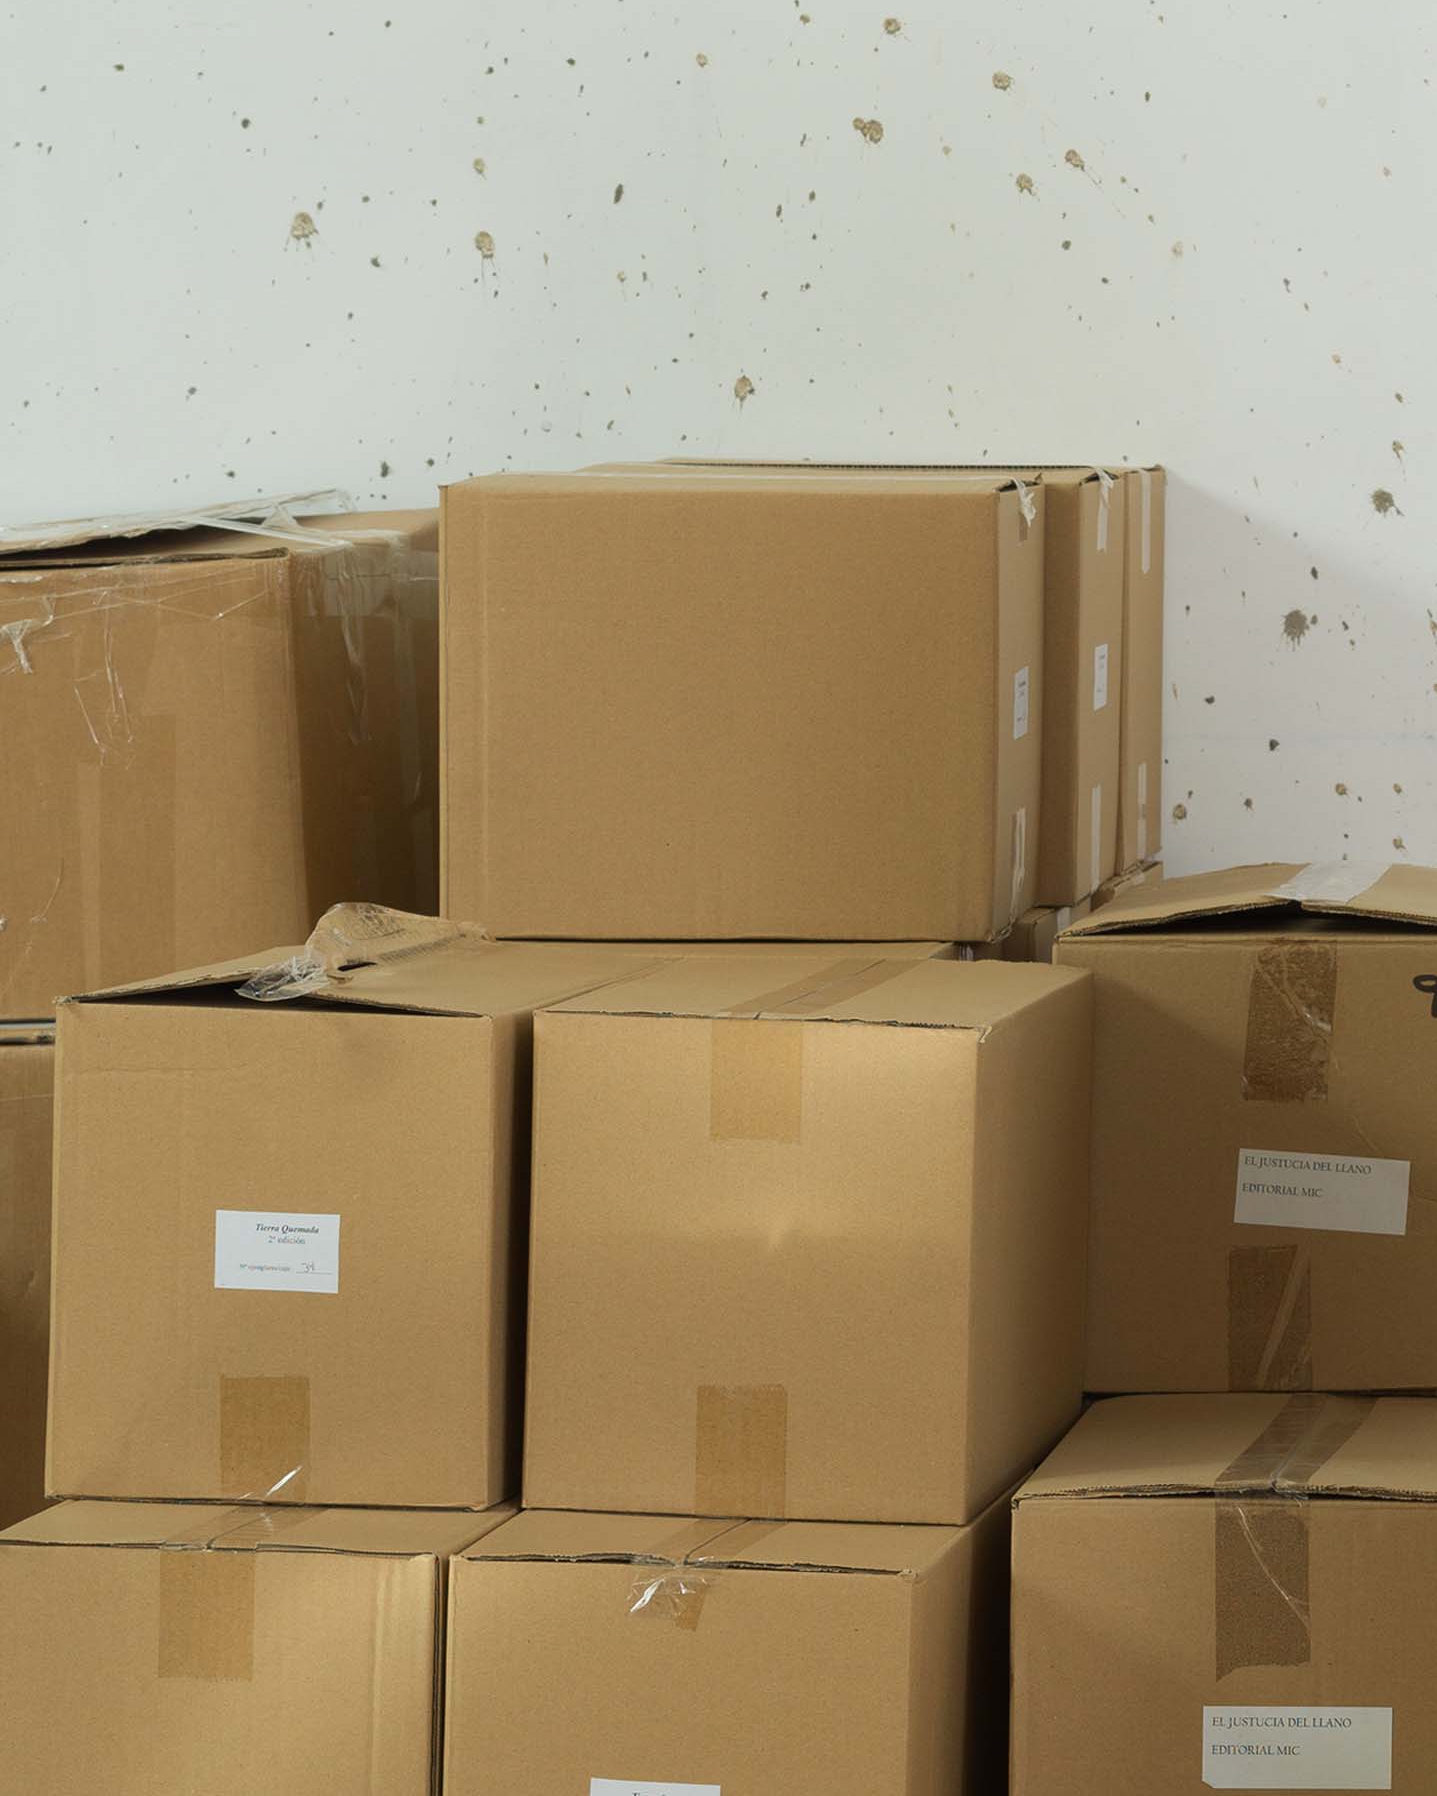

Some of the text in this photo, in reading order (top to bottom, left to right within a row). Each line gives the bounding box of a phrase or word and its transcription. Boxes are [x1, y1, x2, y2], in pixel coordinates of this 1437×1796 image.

[1244, 1155, 1372, 1175] EL JUSTUCIA DEL LLANO
[1242, 1182, 1324, 1198] EDITORIAL MIC
[256, 1223, 279, 1232] Tierra
[1212, 1717, 1352, 1729] EL JUSTUCIA DEL LLANO
[1212, 1744, 1300, 1755] EDITORIAL MIC
